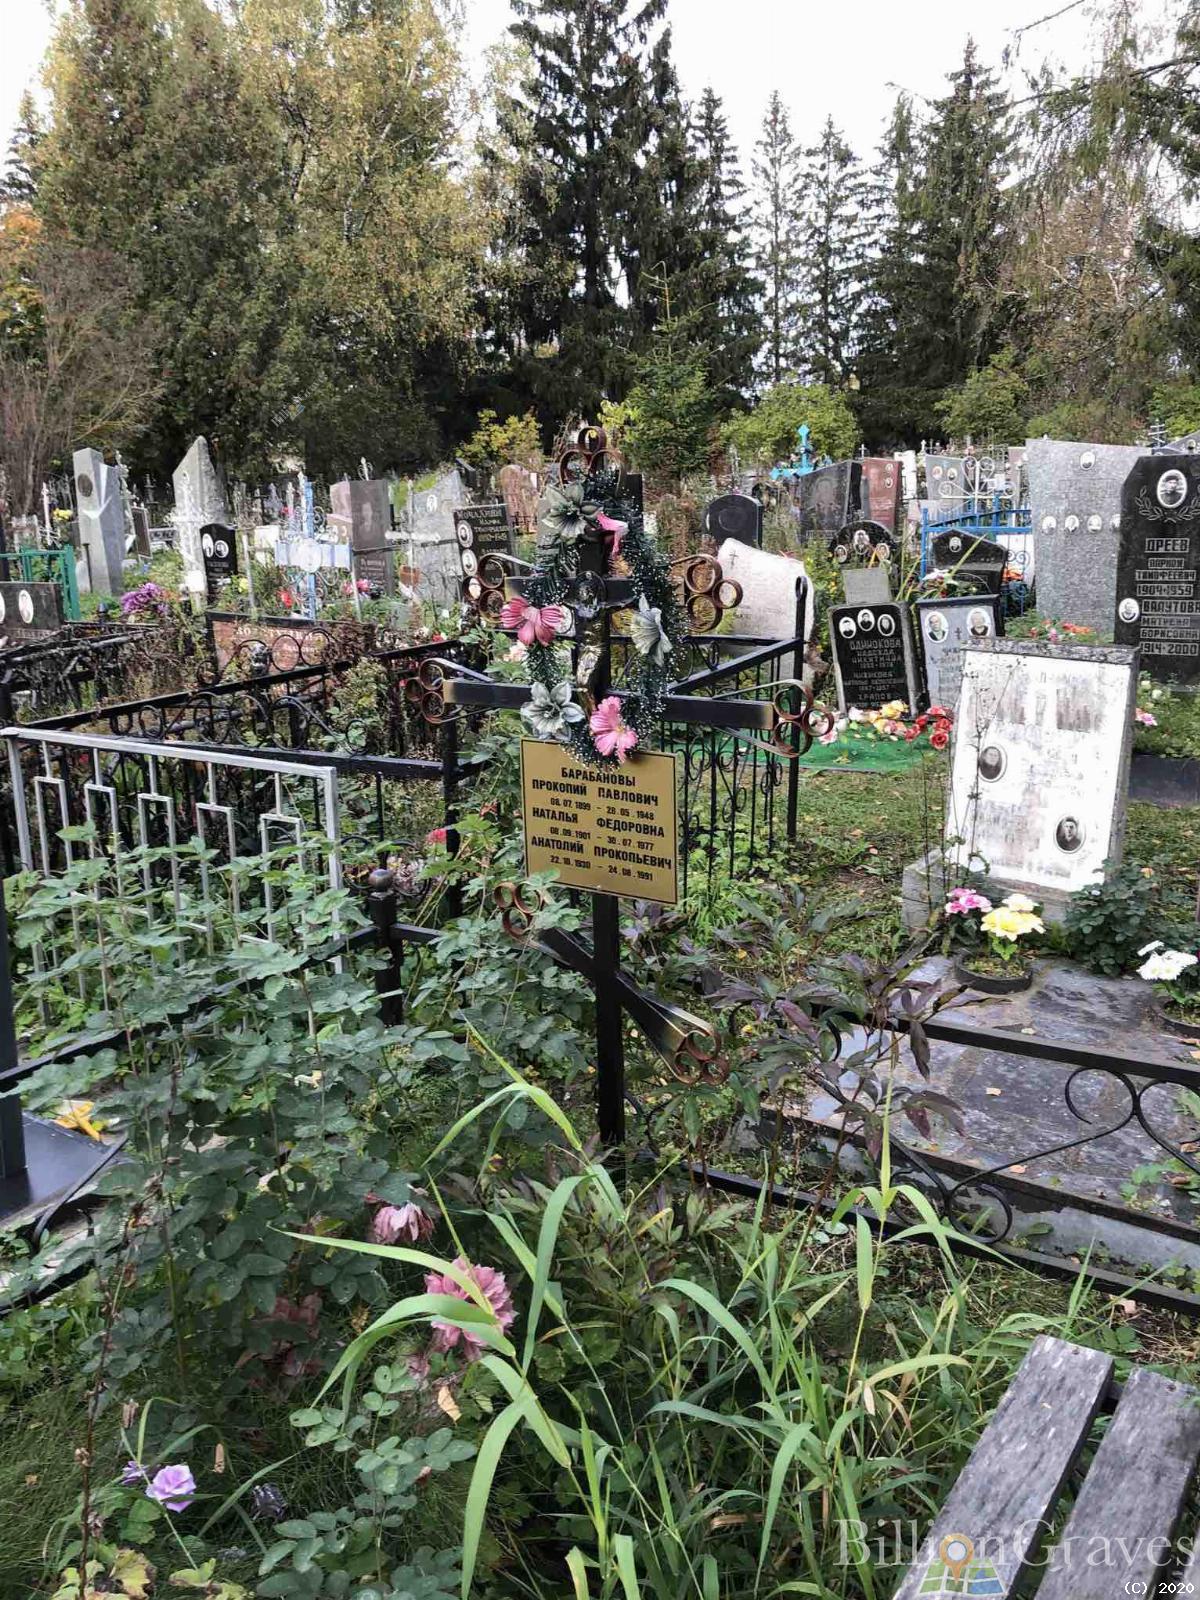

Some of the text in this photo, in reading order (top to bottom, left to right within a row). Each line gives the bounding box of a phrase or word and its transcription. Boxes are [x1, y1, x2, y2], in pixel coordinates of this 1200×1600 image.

[561, 767, 635, 787] БАРАБАНОВЫ
[532, 779, 658, 806] ПРОКОПИЙ ПАВЛОВИЧ
[532, 807, 665, 838] НАТАЛЬЯ ФЕДОРОВНА
[531, 836, 672, 870] АНАТОЛИЙ ПРОКОПЬЕВИЧ
